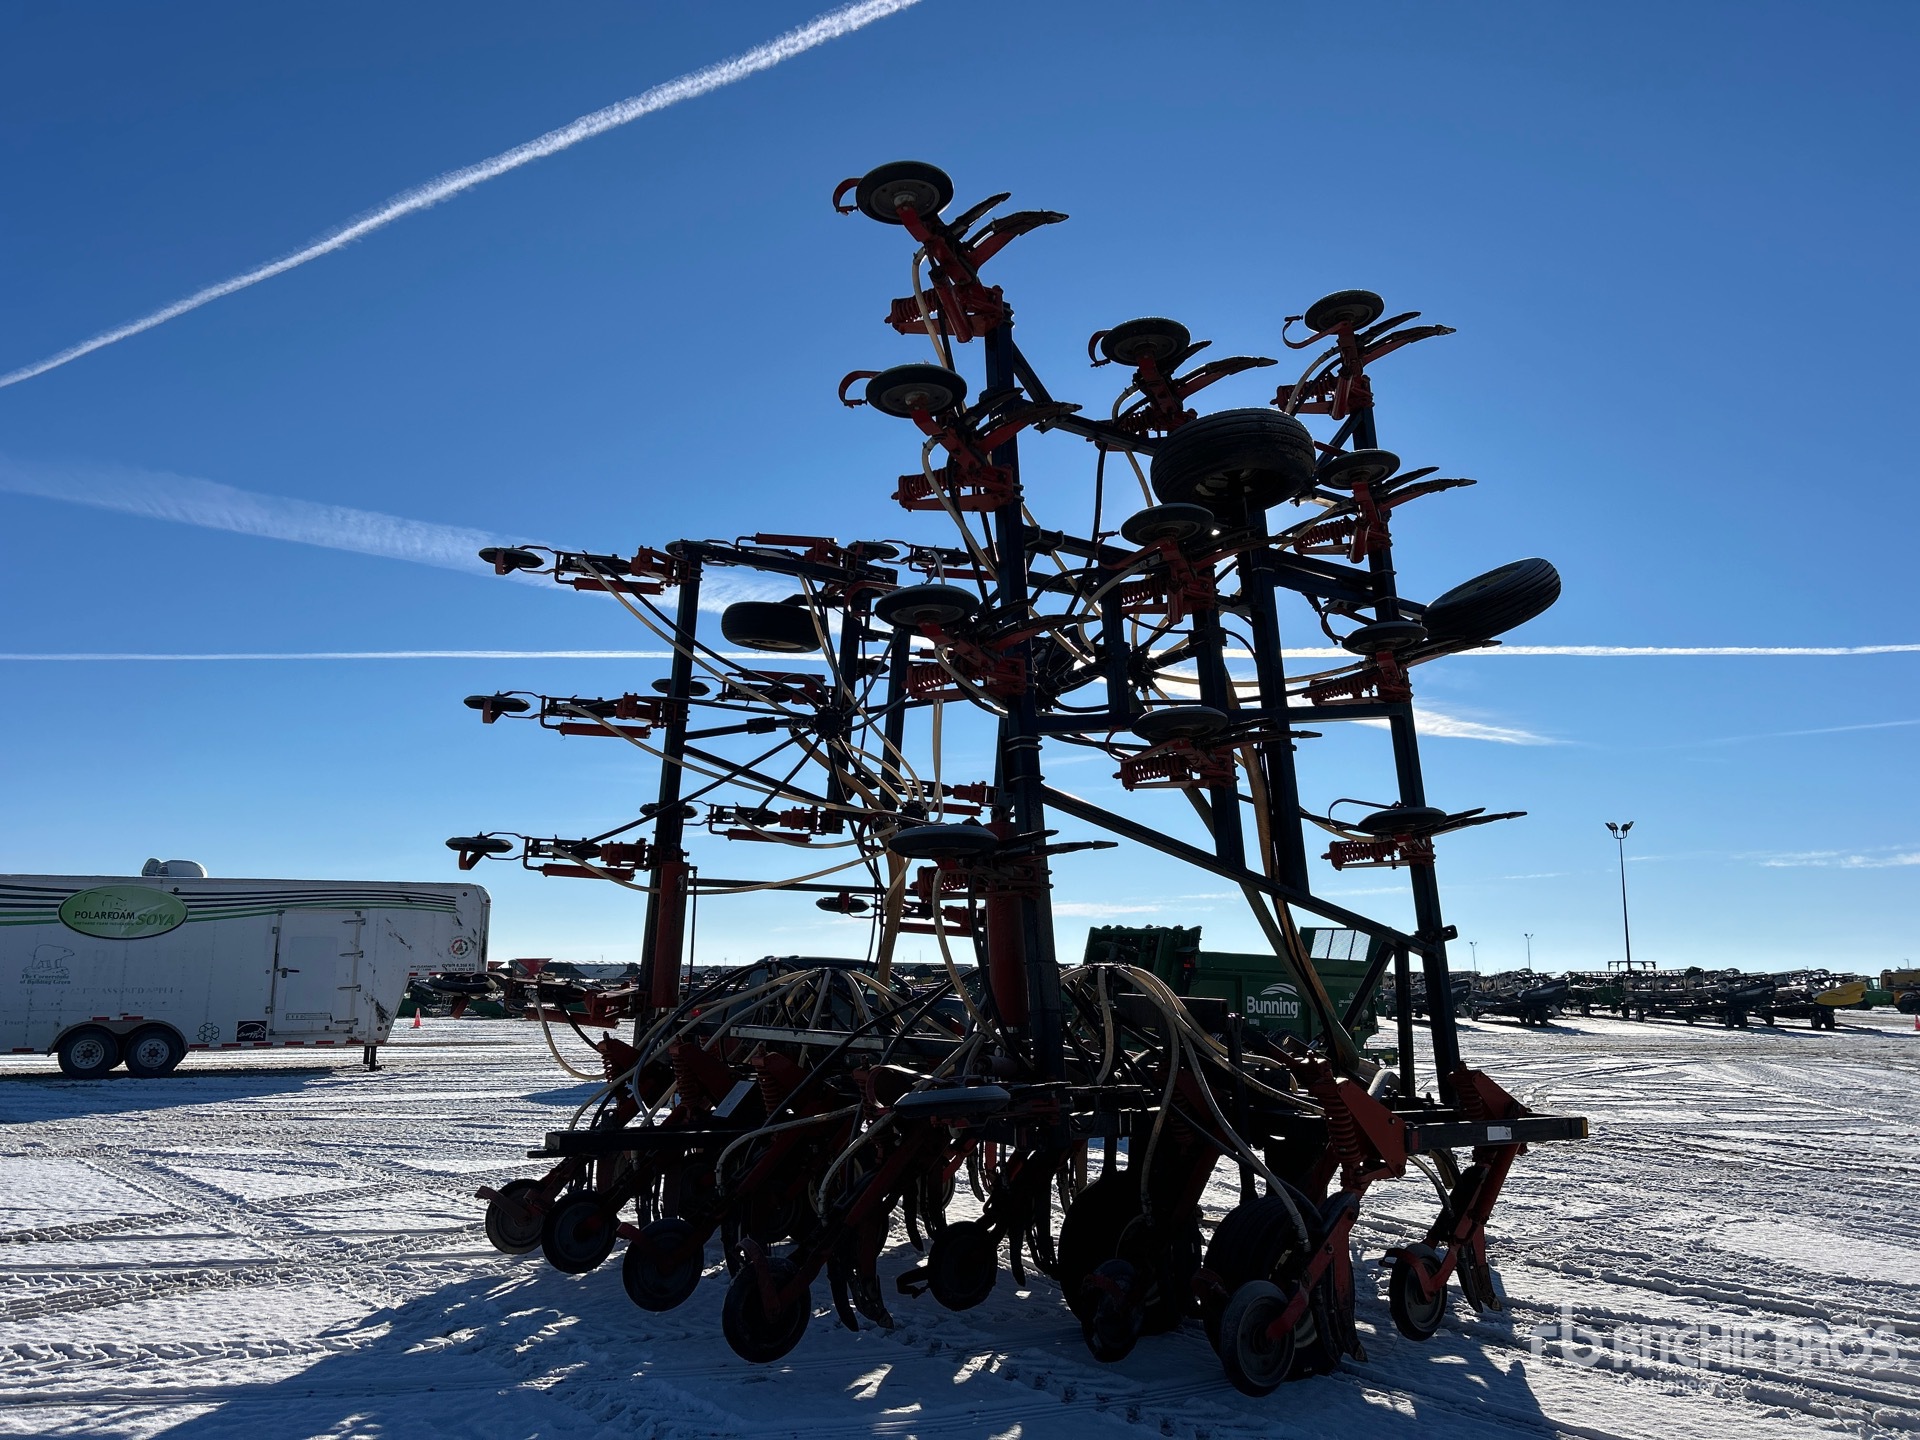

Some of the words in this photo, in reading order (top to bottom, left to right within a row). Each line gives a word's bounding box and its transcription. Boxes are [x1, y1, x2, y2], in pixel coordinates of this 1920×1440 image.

[73, 910, 135, 920] POLARFOAM
[136, 913, 176, 926] SOYA
[1246, 995, 1299, 1019] Bunning
